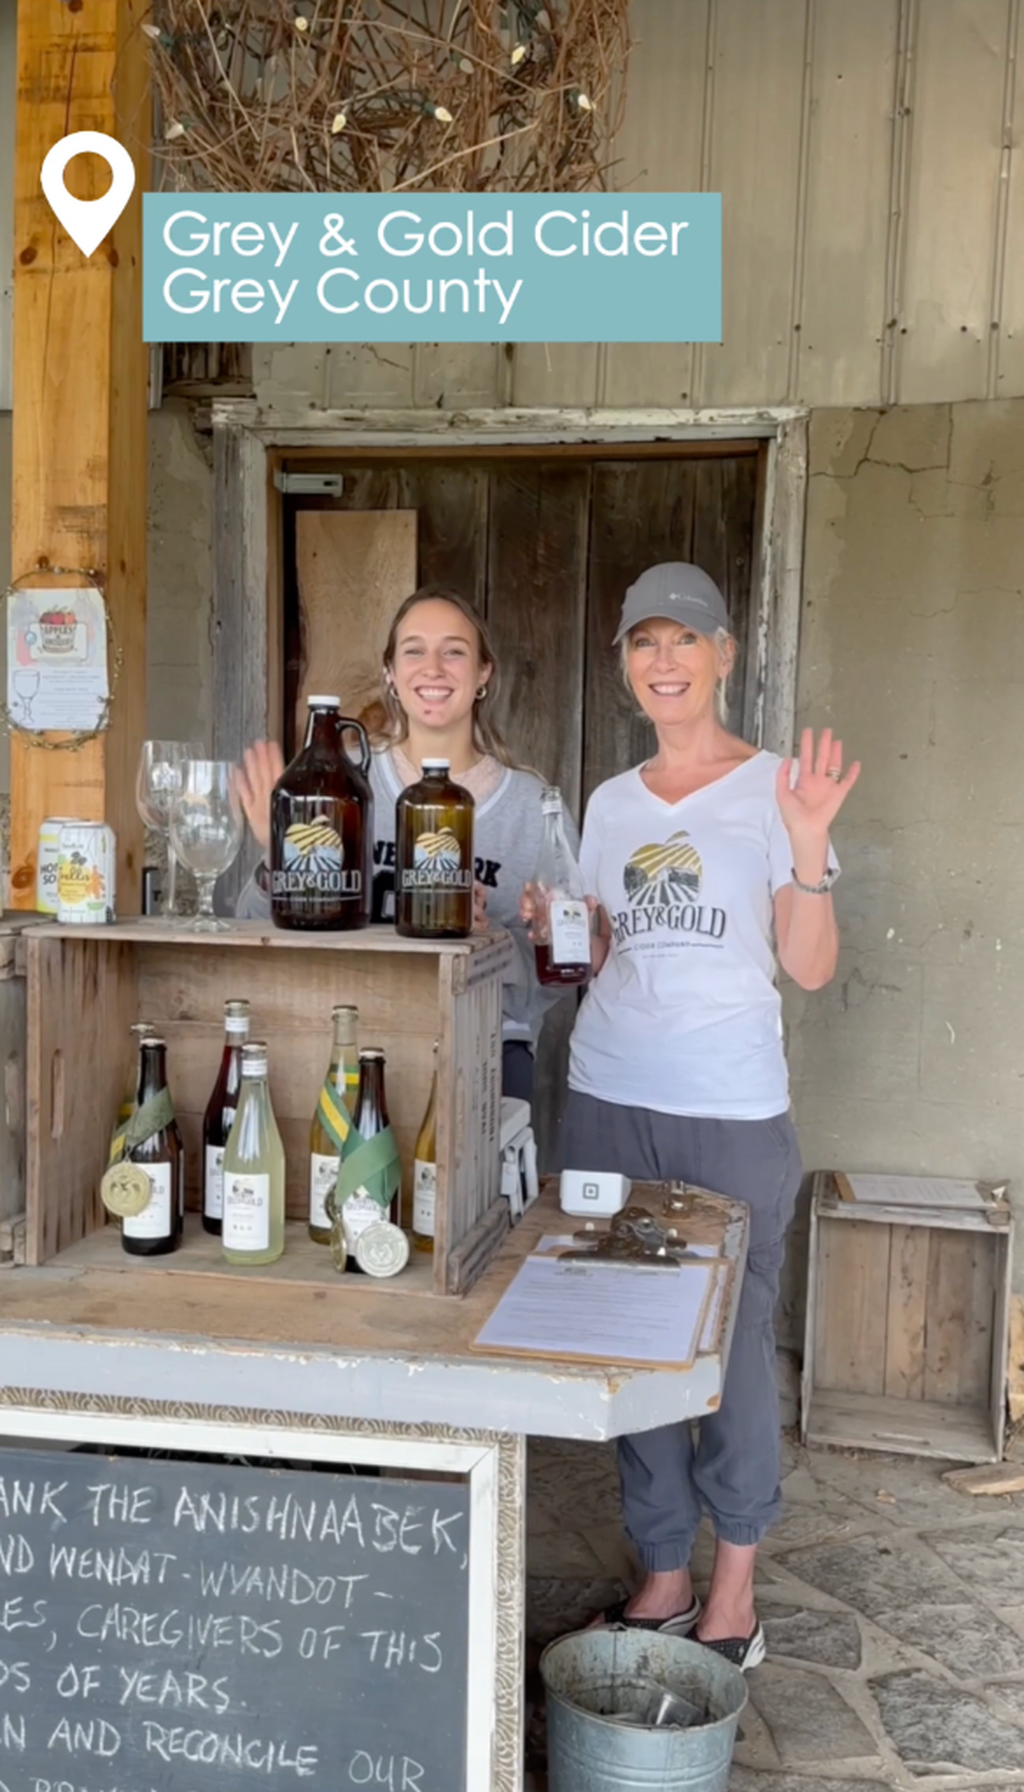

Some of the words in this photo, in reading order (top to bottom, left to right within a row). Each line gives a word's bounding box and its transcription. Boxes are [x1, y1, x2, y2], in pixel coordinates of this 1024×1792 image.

[86, 1483, 151, 1526] THE
[77, 1602, 282, 1658] CAREGIVERS
[300, 1626, 345, 1659] OF
[358, 1630, 442, 1672] THIS
[57, 1662, 100, 1698] OF
[48, 1717, 122, 1757] AND
[142, 1720, 319, 1777] RECONCILE
[348, 1749, 426, 1792] OUR
